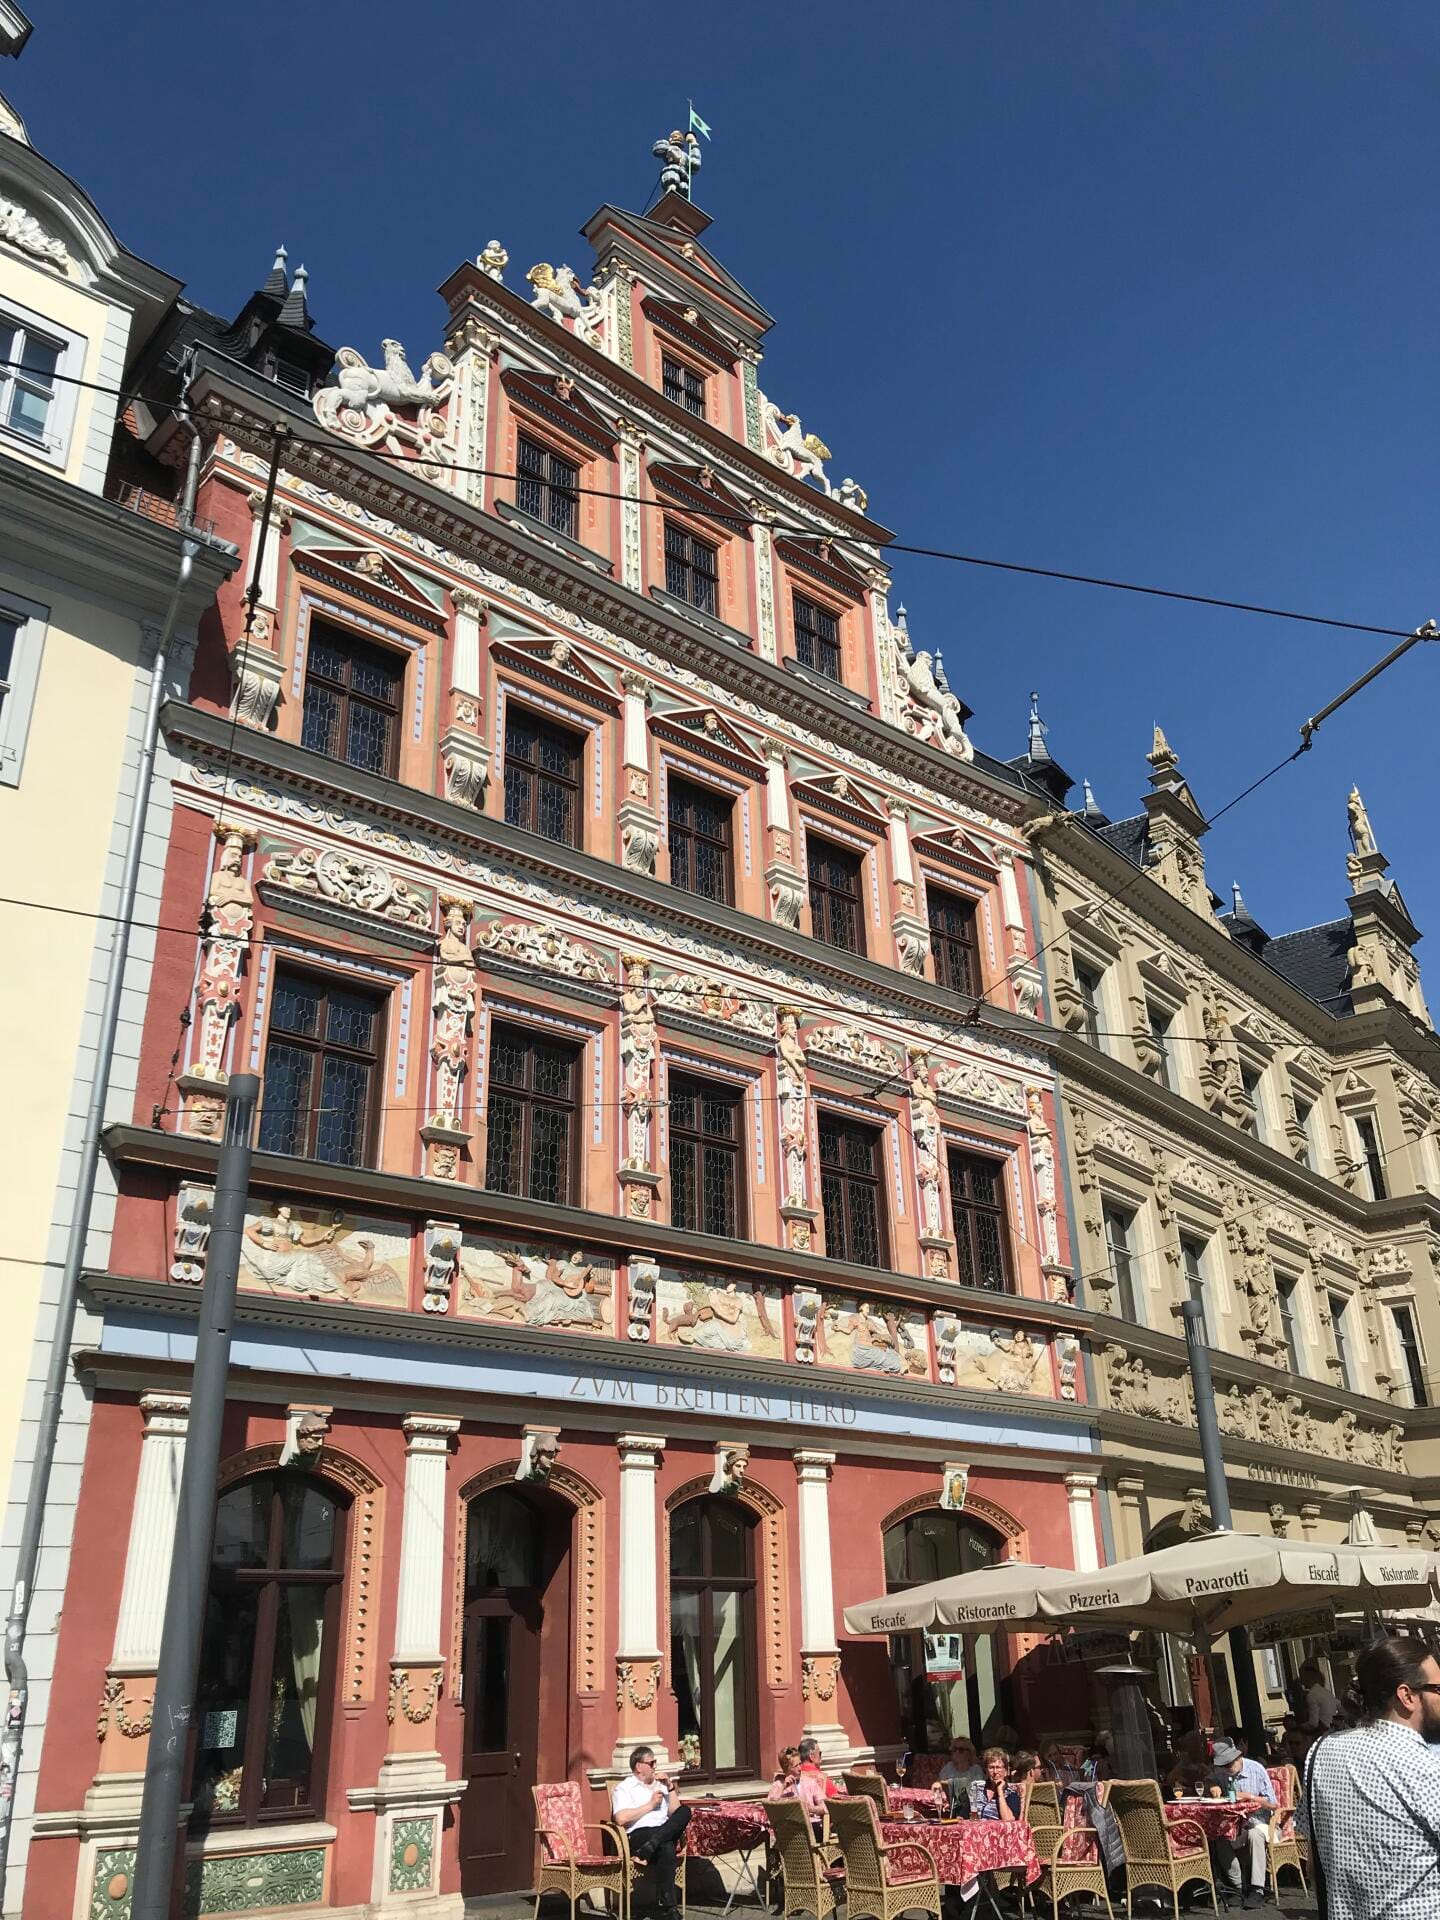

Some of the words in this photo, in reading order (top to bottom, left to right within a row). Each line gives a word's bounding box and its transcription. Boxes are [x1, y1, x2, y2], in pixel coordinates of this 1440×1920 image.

[655, 1376, 771, 1415] BREITEN
[788, 1391, 857, 1425] HERD
[1185, 1568, 1250, 1594] Pavarotti
[1379, 1566, 1420, 1582] Ristorante
[1069, 1589, 1120, 1609] Pizzeria
[957, 1602, 1016, 1621] Ristorante
